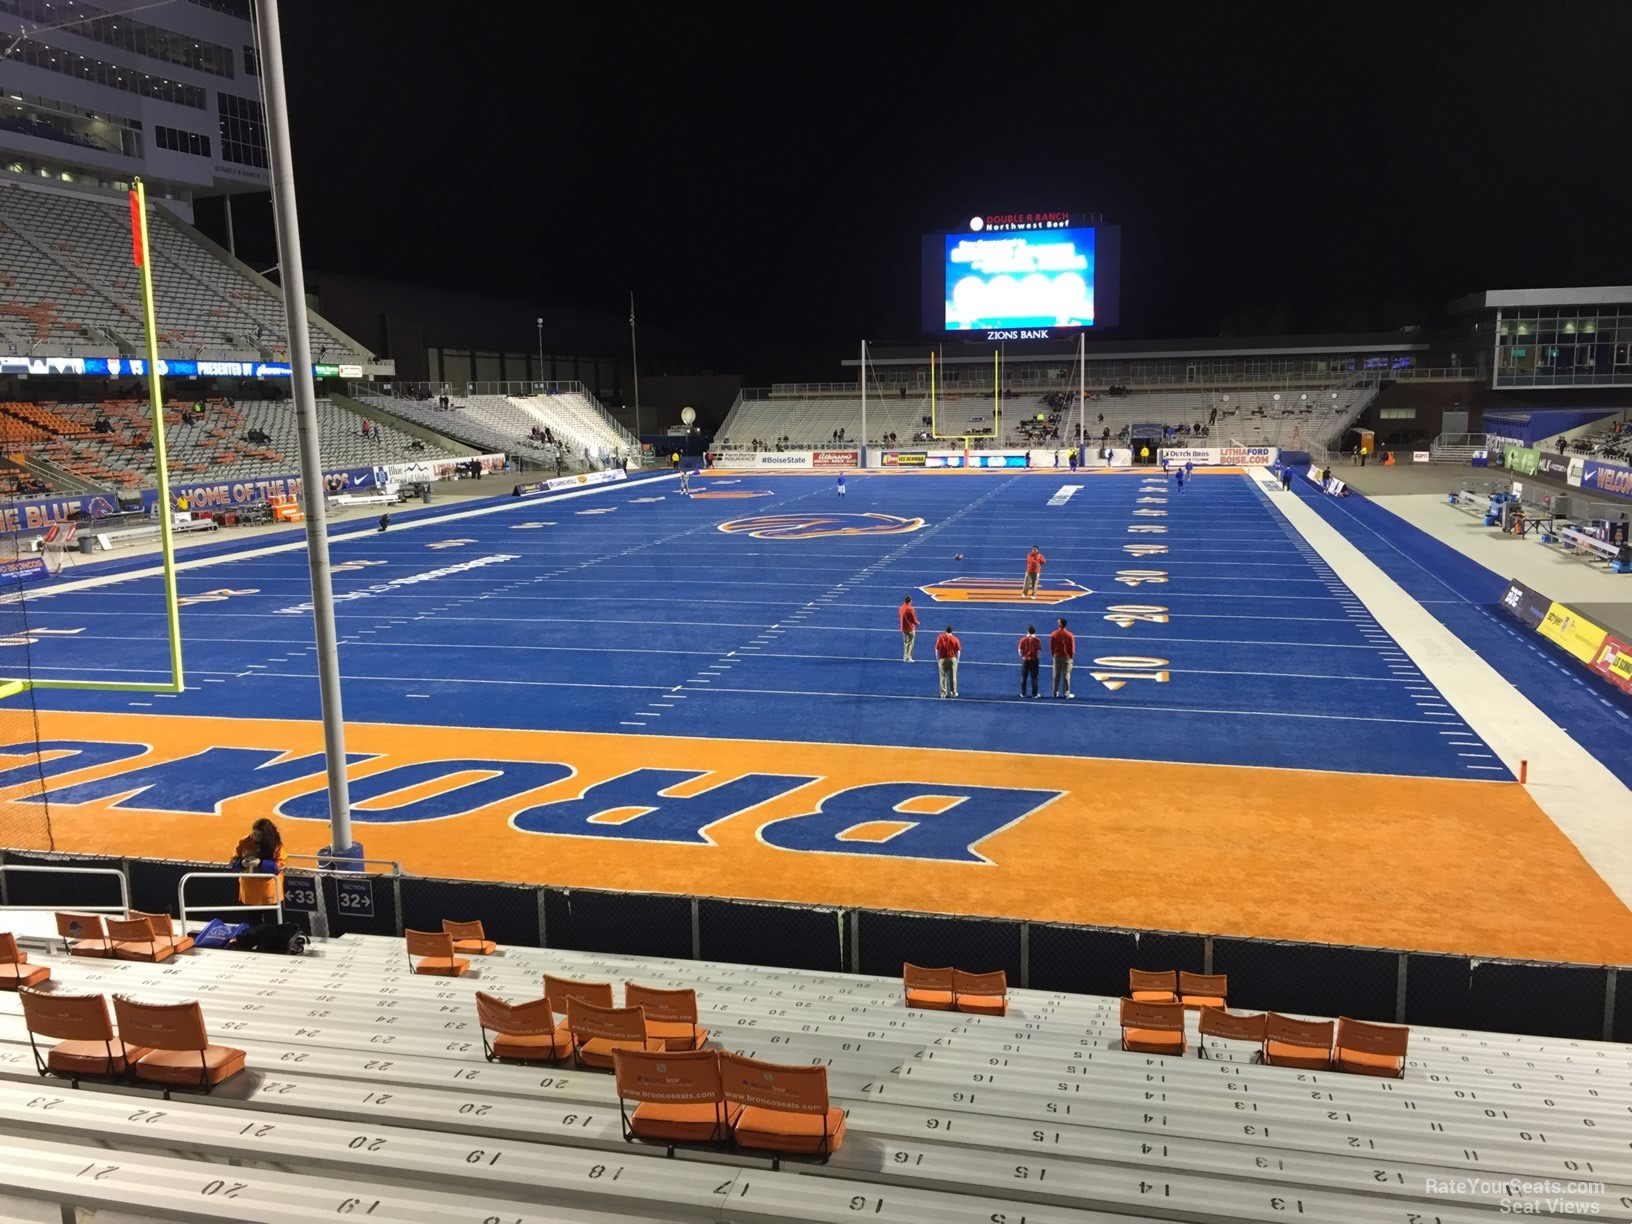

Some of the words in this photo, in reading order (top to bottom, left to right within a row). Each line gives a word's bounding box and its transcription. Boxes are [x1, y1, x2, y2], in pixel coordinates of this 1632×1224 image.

[986, 213, 1024, 224] DOUBLE
[1027, 213, 1033, 222] R
[1035, 211, 1069, 221] RANCH
[986, 221, 1042, 231] Northwest
[1047, 219, 1070, 228] Beef
[987, 330, 1018, 340] ZIONS
[1020, 329, 1049, 339] BANK
[762, 456, 806, 464] #BoiseState
[1220, 456, 1269, 464] BOISE.COM
[388, 465, 403, 476] Blue
[181, 485, 229, 508] HOME
[233, 484, 254, 501] OF
[255, 480, 285, 498] THE
[25, 501, 81, 529] BLUE
[1114, 569, 1169, 583] 30
[1103, 604, 1169, 624] 20
[1089, 656, 1170, 682] 10
[295, 890, 315, 904] 33
[340, 893, 361, 908] 32
[440, 1005, 461, 1013] 24
[221, 1022, 248, 1030] 25
[738, 1018, 757, 1026] 20
[295, 1028, 320, 1037] 24
[1025, 1024, 1040, 1032] 16
[370, 1035, 396, 1044] 23
[771, 1036, 790, 1044] 19
[446, 1041, 472, 1051] 22
[842, 1043, 861, 1051] 18
[281, 1052, 310, 1063] 23
[735, 1050, 756, 1058] 19
[913, 1048, 933, 1059] 17
[364, 1061, 393, 1072] 22
[812, 1058, 832, 1068] 18
[989, 1058, 1008, 1067] 16
[1146, 1059, 1164, 1068] 14
[453, 1070, 480, 1081] 21
[890, 1064, 912, 1076] 17
[1064, 1067, 1087, 1076] 15
[1220, 1066, 1240, 1075] 13
[973, 1075, 994, 1084] 16
[1146, 1074, 1165, 1084] 14
[1297, 1075, 1317, 1084] 12
[1430, 1074, 1451, 1083] 10
[261, 1082, 297, 1094] 22
[540, 1079, 569, 1090] 20
[860, 1084, 884, 1095] 17
[1057, 1084, 1080, 1093] 15
[1227, 1084, 1248, 1093] 13
[1381, 1084, 1392, 1092] 11
[623, 1087, 715, 1099] www.broncoseats.com
[1311, 1092, 1333, 1102] 12
[1454, 1090, 1476, 1099] 10
[27, 1098, 64, 1110] 23
[362, 1094, 393, 1105] 21
[724, 1091, 822, 1111] www.broncoseats.com
[953, 1094, 975, 1104] 16
[1144, 1093, 1166, 1105] 14
[459, 1105, 493, 1116] 20
[1046, 1104, 1070, 1114] 15
[1234, 1102, 1257, 1111] 13
[1404, 1102, 1416, 1110] 11
[128, 1110, 167, 1123] 22
[1144, 1114, 1167, 1126] 14
[1327, 1112, 1351, 1122] 12
[1484, 1110, 1508, 1119] 10
[562, 1114, 593, 1127] 19
[926, 1119, 951, 1131] 16
[239, 1123, 276, 1137] 21
[1243, 1125, 1269, 1137] 13
[1430, 1122, 1443, 1132] 11
[1031, 1131, 1059, 1144] 15
[1519, 1132, 1546, 1143] 10
[348, 1136, 387, 1151] 20
[1347, 1137, 1374, 1150] 12
[1141, 1143, 1167, 1157] 14
[1464, 1150, 1478, 1161] 11
[465, 1150, 502, 1166] 19
[894, 1152, 923, 1165] 16
[1256, 1157, 1283, 1171] 13
[1564, 1161, 1593, 1173] 10
[76, 1163, 120, 1180] 21
[588, 1165, 624, 1181] 18
[1014, 1166, 1046, 1181] 15
[1374, 1169, 1405, 1185] 12
[201, 1180, 248, 1199] 20
[713, 1180, 750, 1197] 17
[1139, 1181, 1169, 1197] 14
[337, 1198, 381, 1215] 19
[849, 1196, 883, 1213] 16
[1270, 1197, 1303, 1213] 13
